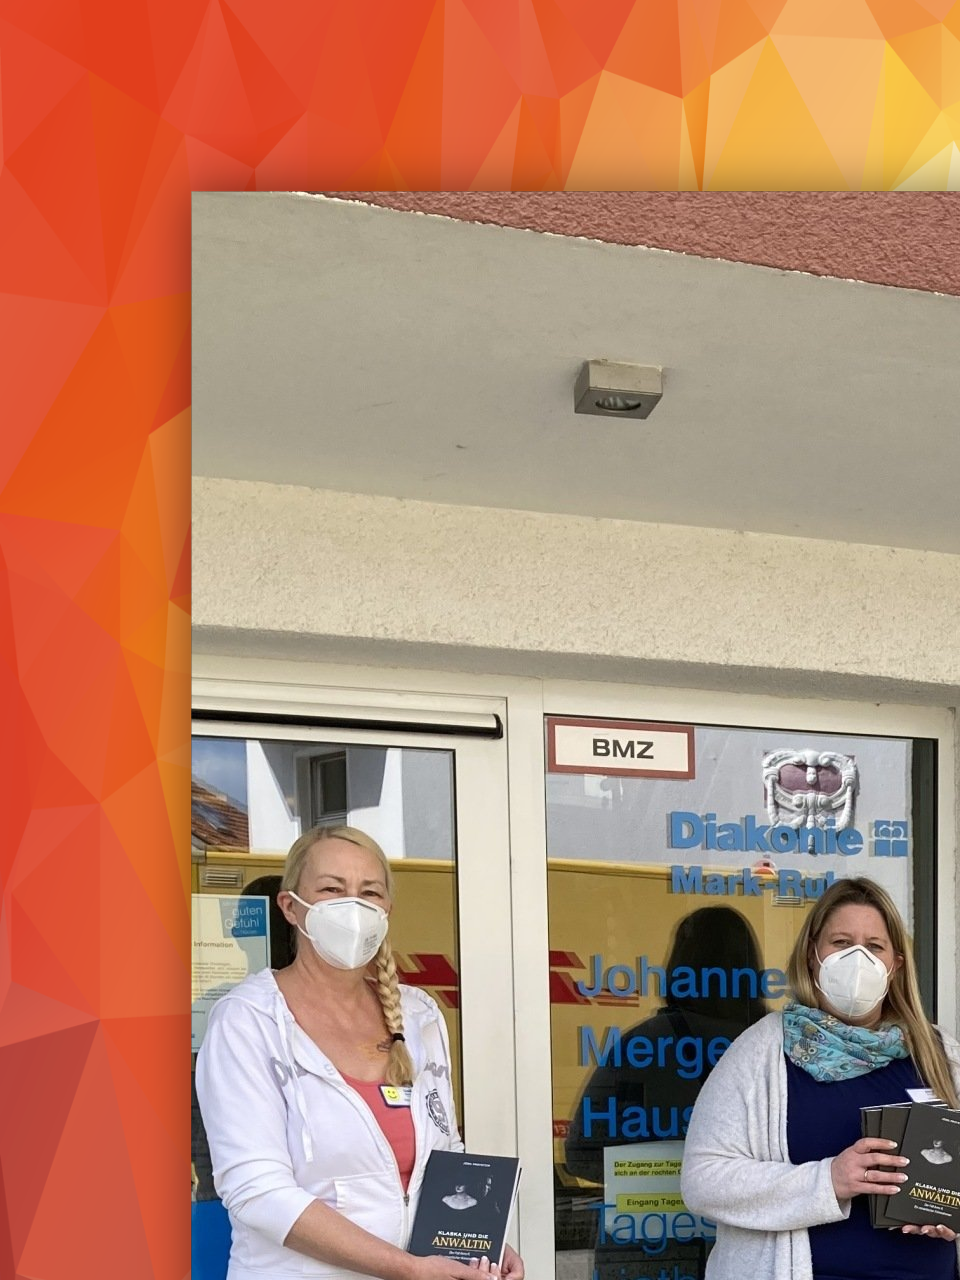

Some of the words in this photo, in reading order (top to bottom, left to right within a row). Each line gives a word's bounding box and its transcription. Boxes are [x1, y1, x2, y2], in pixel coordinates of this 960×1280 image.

[592, 738, 655, 760] BMZ
[669, 810, 864, 856] Diakonie
[670, 865, 835, 898] Mark-Ru
[627, 1161, 653, 1169] Zugang
[626, 1198, 659, 1207] Eingang
